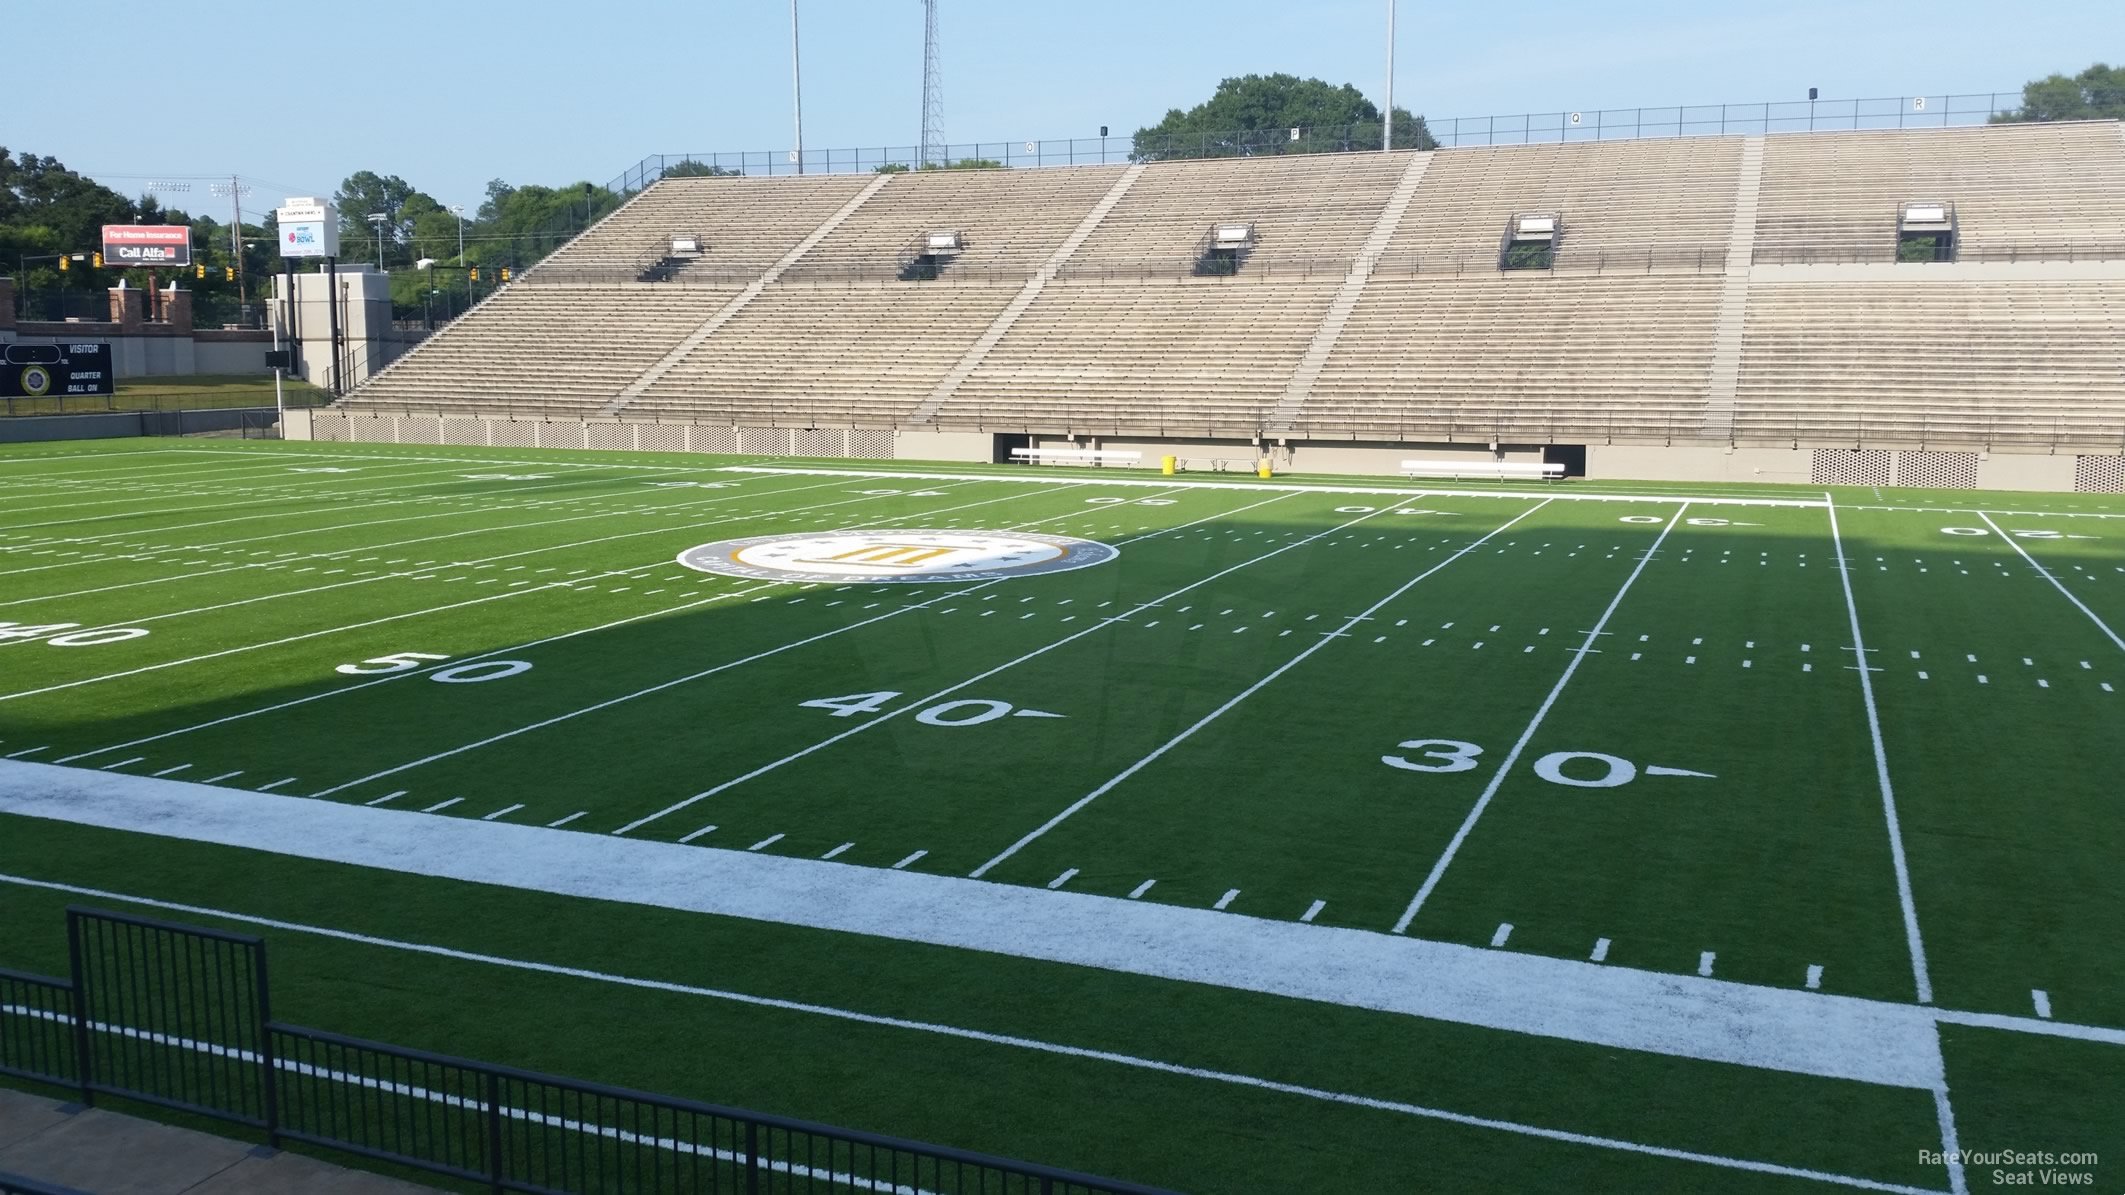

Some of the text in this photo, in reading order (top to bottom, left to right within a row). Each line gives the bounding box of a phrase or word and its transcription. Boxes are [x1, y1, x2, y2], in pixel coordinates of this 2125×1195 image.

[109, 230, 183, 240] For Home Insurance
[119, 246, 165, 258] Call Alfa
[69, 344, 99, 354] VISITOR
[70, 371, 102, 380] QUARTER
[67, 384, 98, 393] BALL ON
[781, 573, 831, 581] OF
[842, 571, 1003, 582] DREAMS
